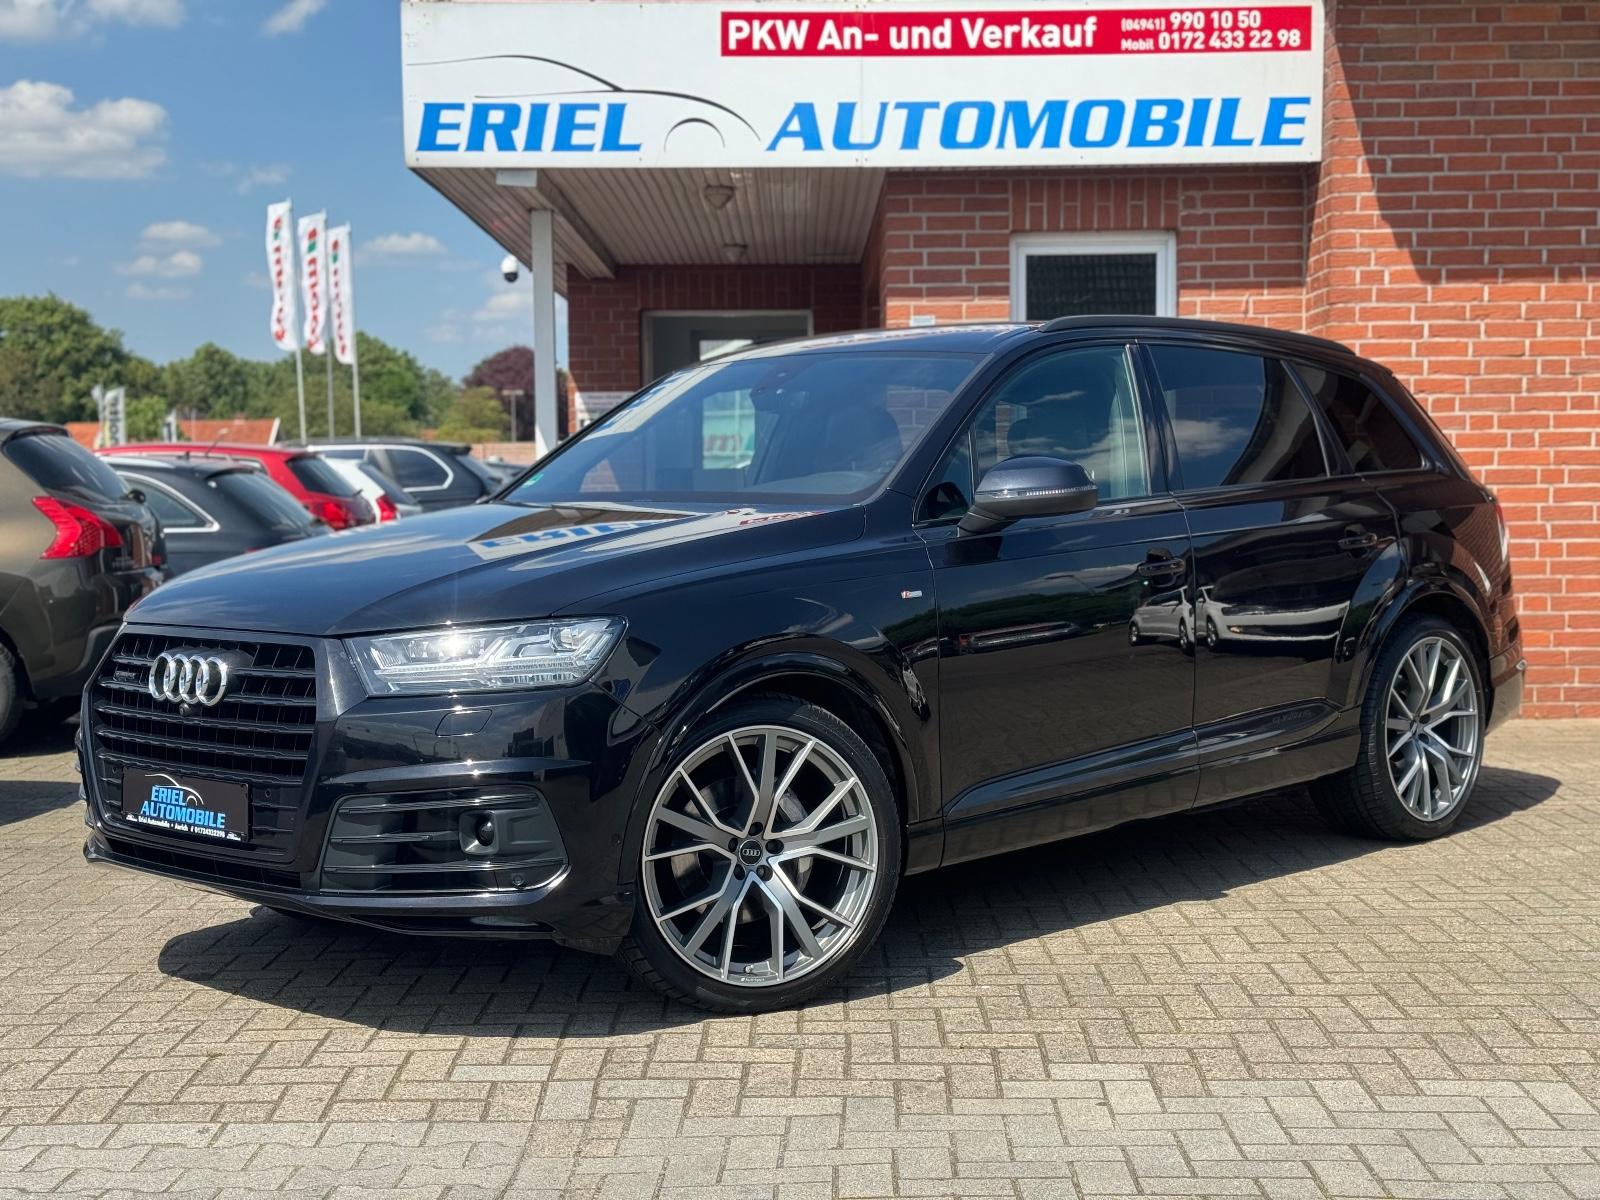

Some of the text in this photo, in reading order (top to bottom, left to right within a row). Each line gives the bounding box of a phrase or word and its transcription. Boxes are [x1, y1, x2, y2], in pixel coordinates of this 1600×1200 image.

[728, 16, 1097, 51] PKW An- und Verkauf
[1120, 9, 1262, 32] (04941) 990 10 50
[1120, 28, 1301, 51] Mobil 0172 433 22 98
[416, 96, 1312, 153] ERIEL AUTOMOBILE
[151, 785, 187, 806] ERIEL
[140, 800, 226, 829] AUTOMOBILE
